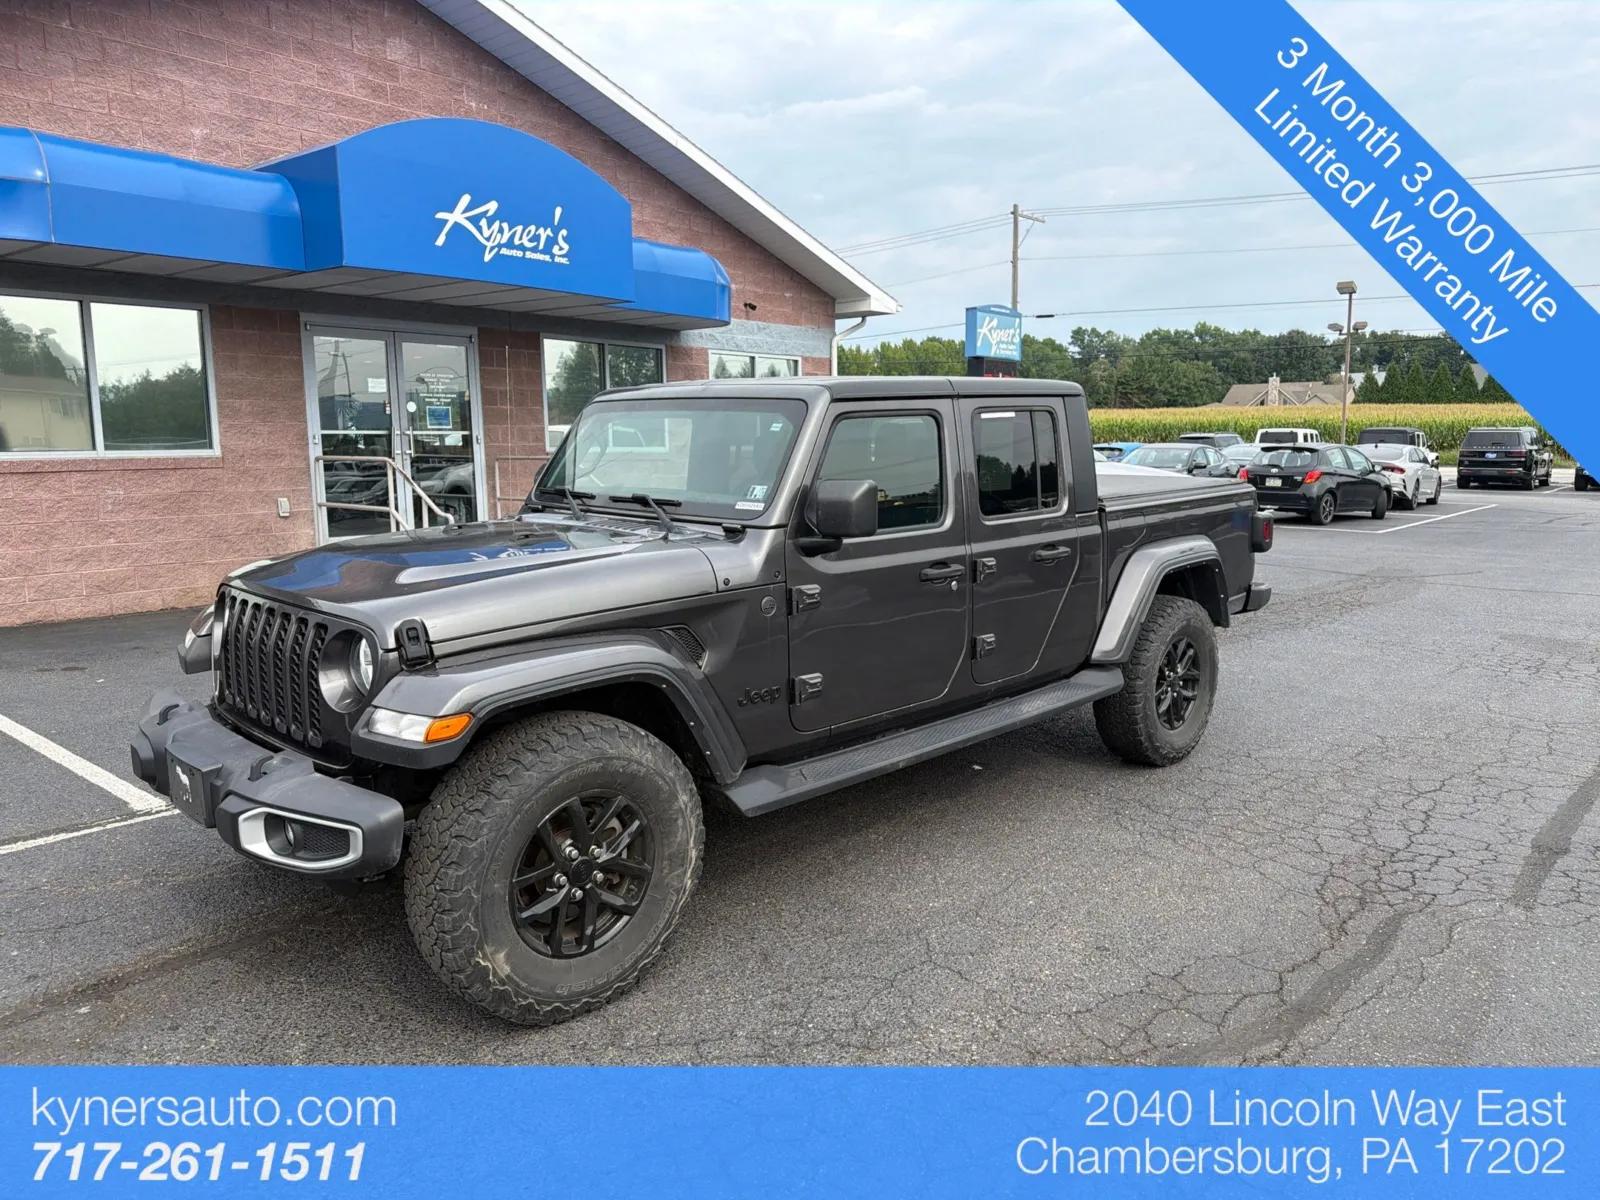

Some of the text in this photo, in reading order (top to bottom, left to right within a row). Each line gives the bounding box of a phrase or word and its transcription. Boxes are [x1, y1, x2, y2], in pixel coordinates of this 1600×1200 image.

[434, 193, 570, 263] Kyner's
[500, 247, 524, 258] Auto
[737, 685, 781, 707] Jeep
